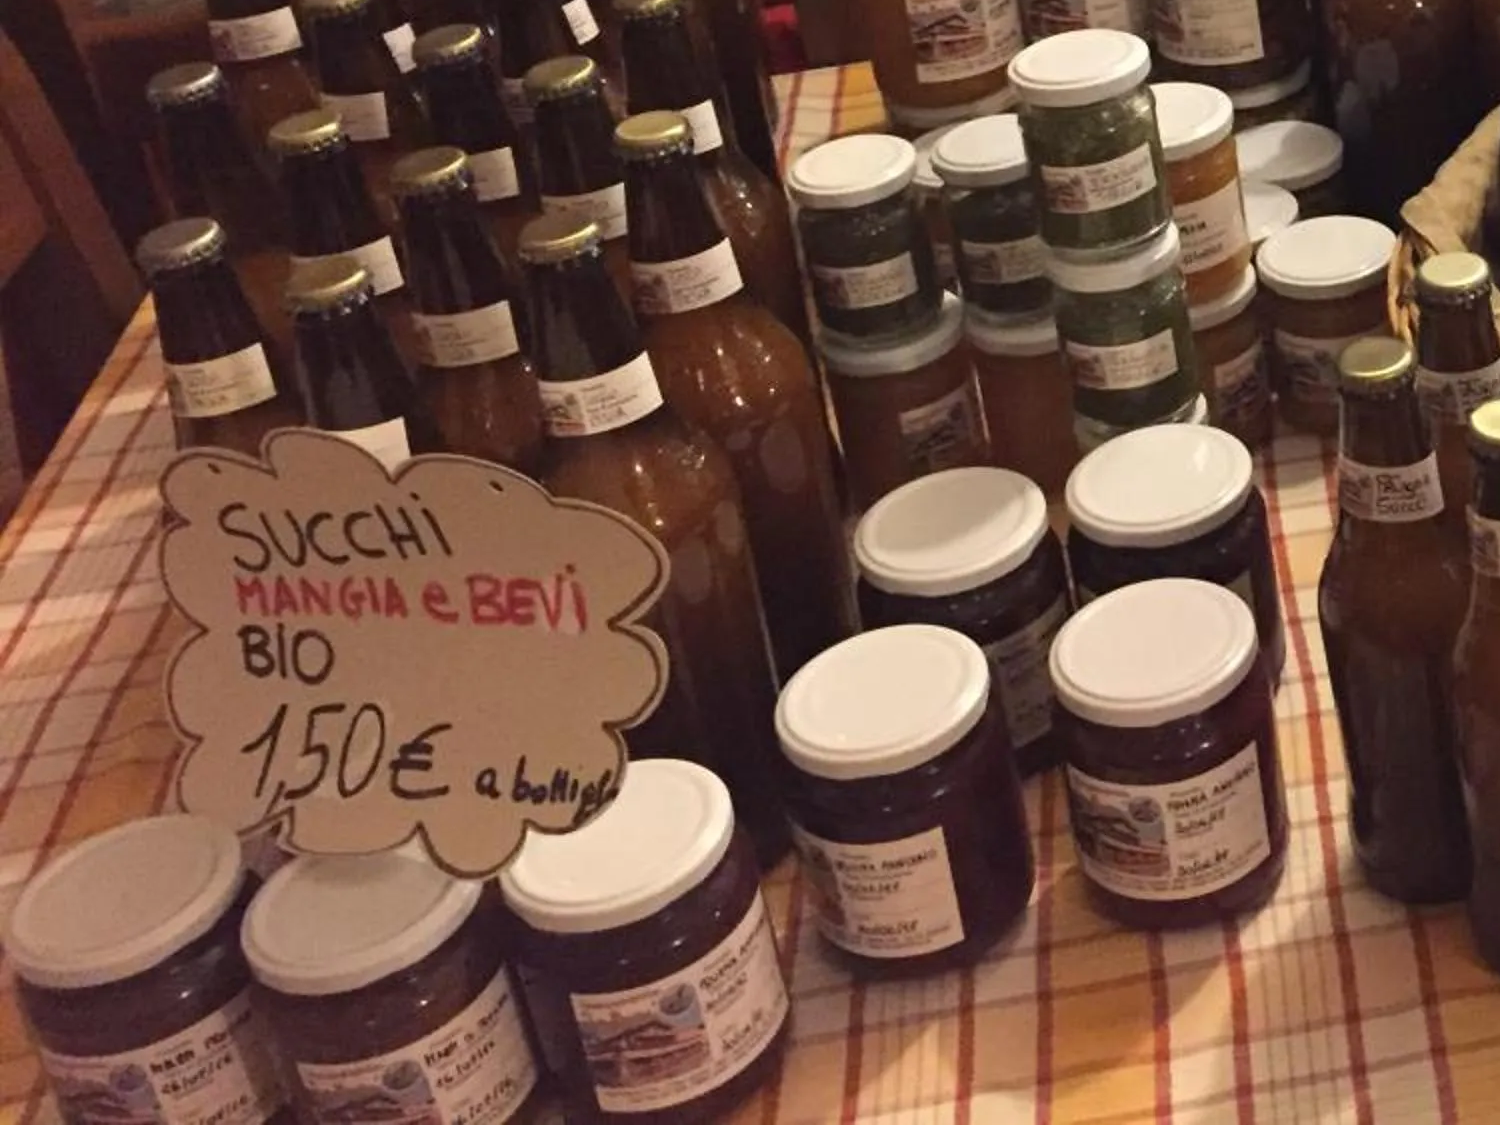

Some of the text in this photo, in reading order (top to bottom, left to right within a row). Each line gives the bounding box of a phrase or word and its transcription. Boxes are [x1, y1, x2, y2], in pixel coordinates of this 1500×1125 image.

[218, 493, 453, 573] SUCCHI
[234, 564, 589, 633] MANGIA e BEVI
[236, 623, 334, 685] BIO
[475, 767, 501, 800] a
